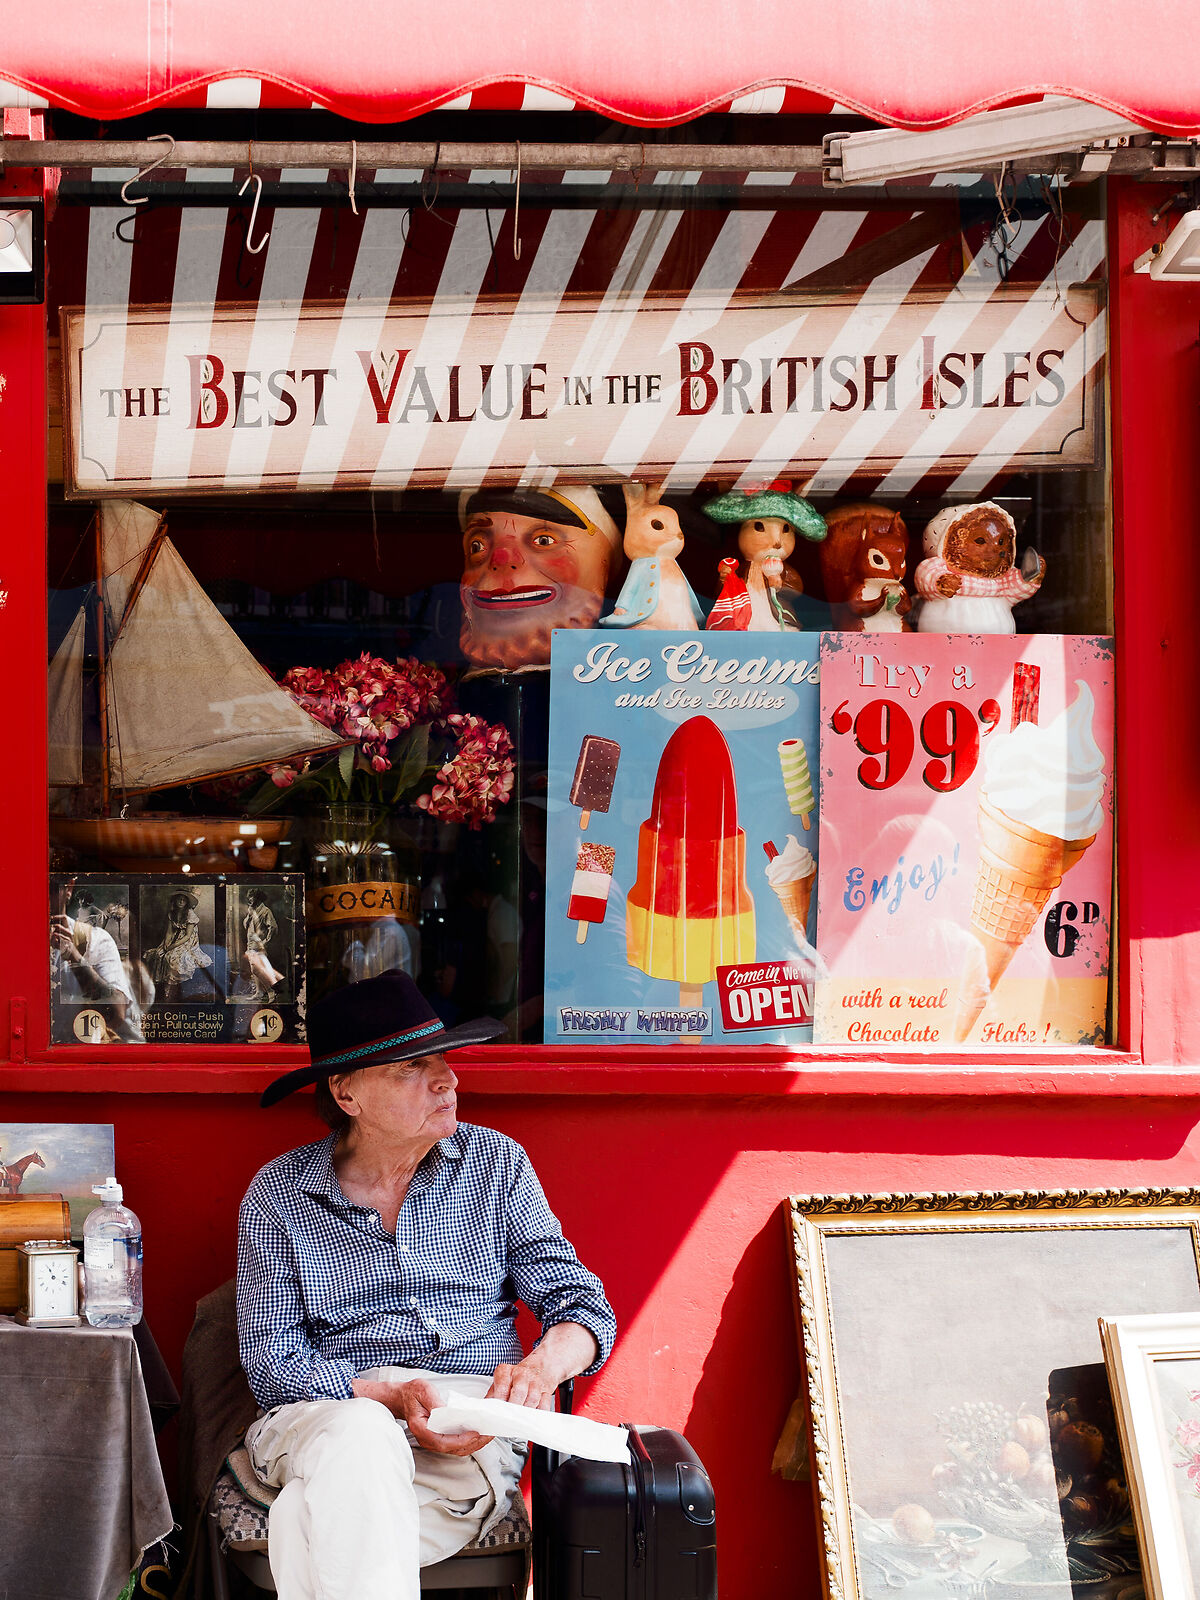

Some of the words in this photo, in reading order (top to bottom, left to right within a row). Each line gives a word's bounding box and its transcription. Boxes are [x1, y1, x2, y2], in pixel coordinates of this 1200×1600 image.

[100, 387, 171, 418] THE
[183, 353, 337, 430] BEST
[354, 349, 549, 425] VALUE
[562, 376, 594, 407] IN
[602, 373, 662, 405] THE
[676, 340, 899, 417] BRITISH
[918, 335, 1066, 411] ISLES
[572, 642, 652, 683] Ice
[853, 654, 935, 698] Try
[952, 664, 976, 690] a
[615, 688, 662, 708] and
[663, 687, 702, 709] Ice
[706, 687, 786, 710] Lollies
[843, 843, 960, 915] Enjoy!
[726, 969, 764, 988] Come
[765, 965, 780, 984] in
[729, 984, 814, 1023] OPEN
[841, 987, 884, 1009] with
[889, 994, 902, 1009] a
[907, 987, 948, 1009] real
[164, 1012, 187, 1021] Coin
[198, 1012, 224, 1021] Push
[183, 1021, 197, 1030] out
[199, 1021, 224, 1031] slowly
[560, 1006, 631, 1032] FRESHLY
[637, 1009, 709, 1033] WHIPPED
[158, 1030, 191, 1039] receive
[194, 1030, 218, 1039] Card
[847, 1021, 940, 1043] Chocolate
